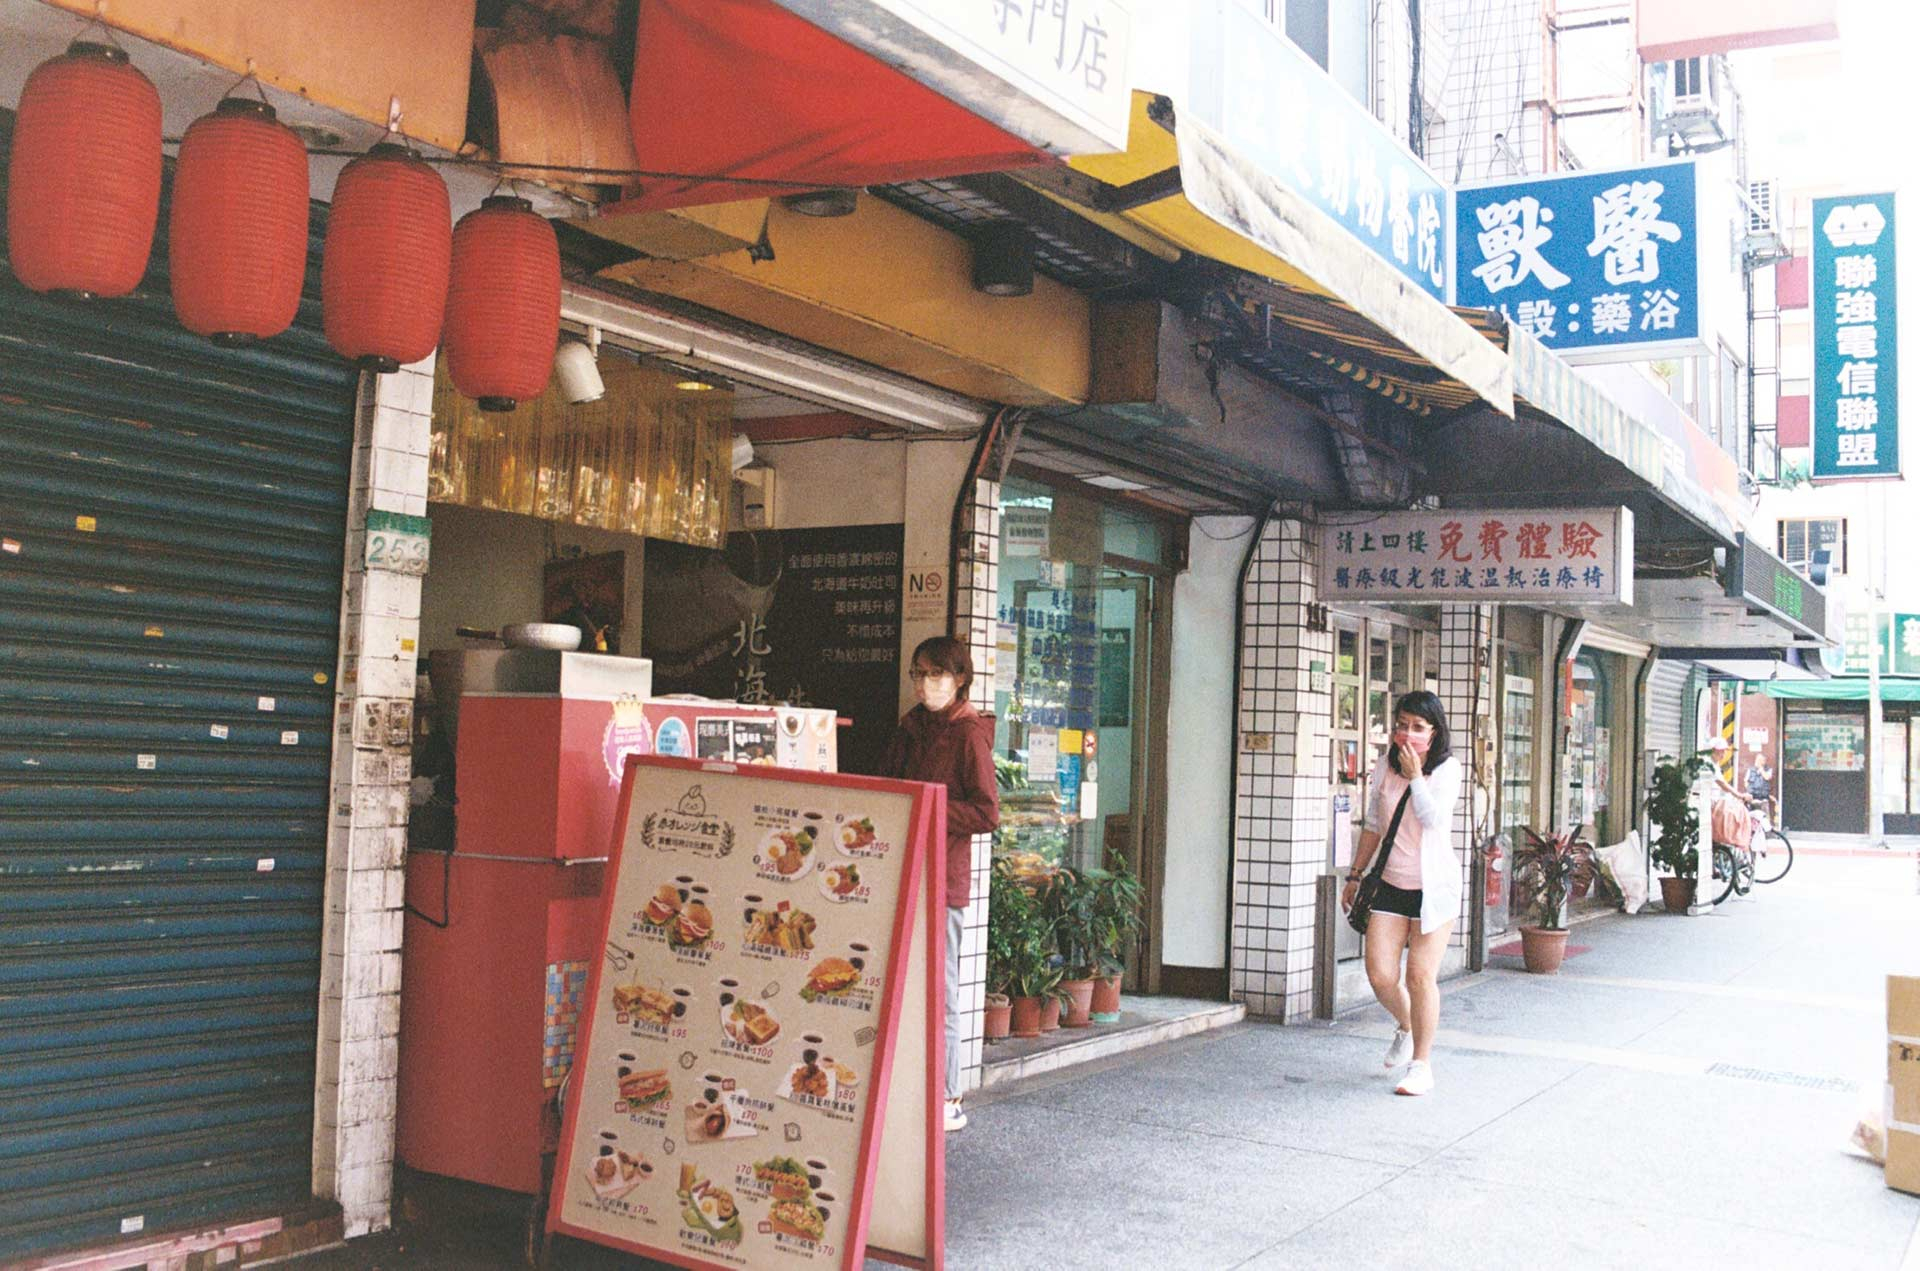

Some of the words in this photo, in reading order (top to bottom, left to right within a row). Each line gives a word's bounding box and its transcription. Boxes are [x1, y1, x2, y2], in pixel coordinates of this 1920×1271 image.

[1472, 180, 1682, 294] 獸醫
[1834, 255, 1879, 467] 聯強電信聯盟
[1336, 530, 1430, 554] 請上四樓
[1436, 520, 1606, 563] 免費體驗
